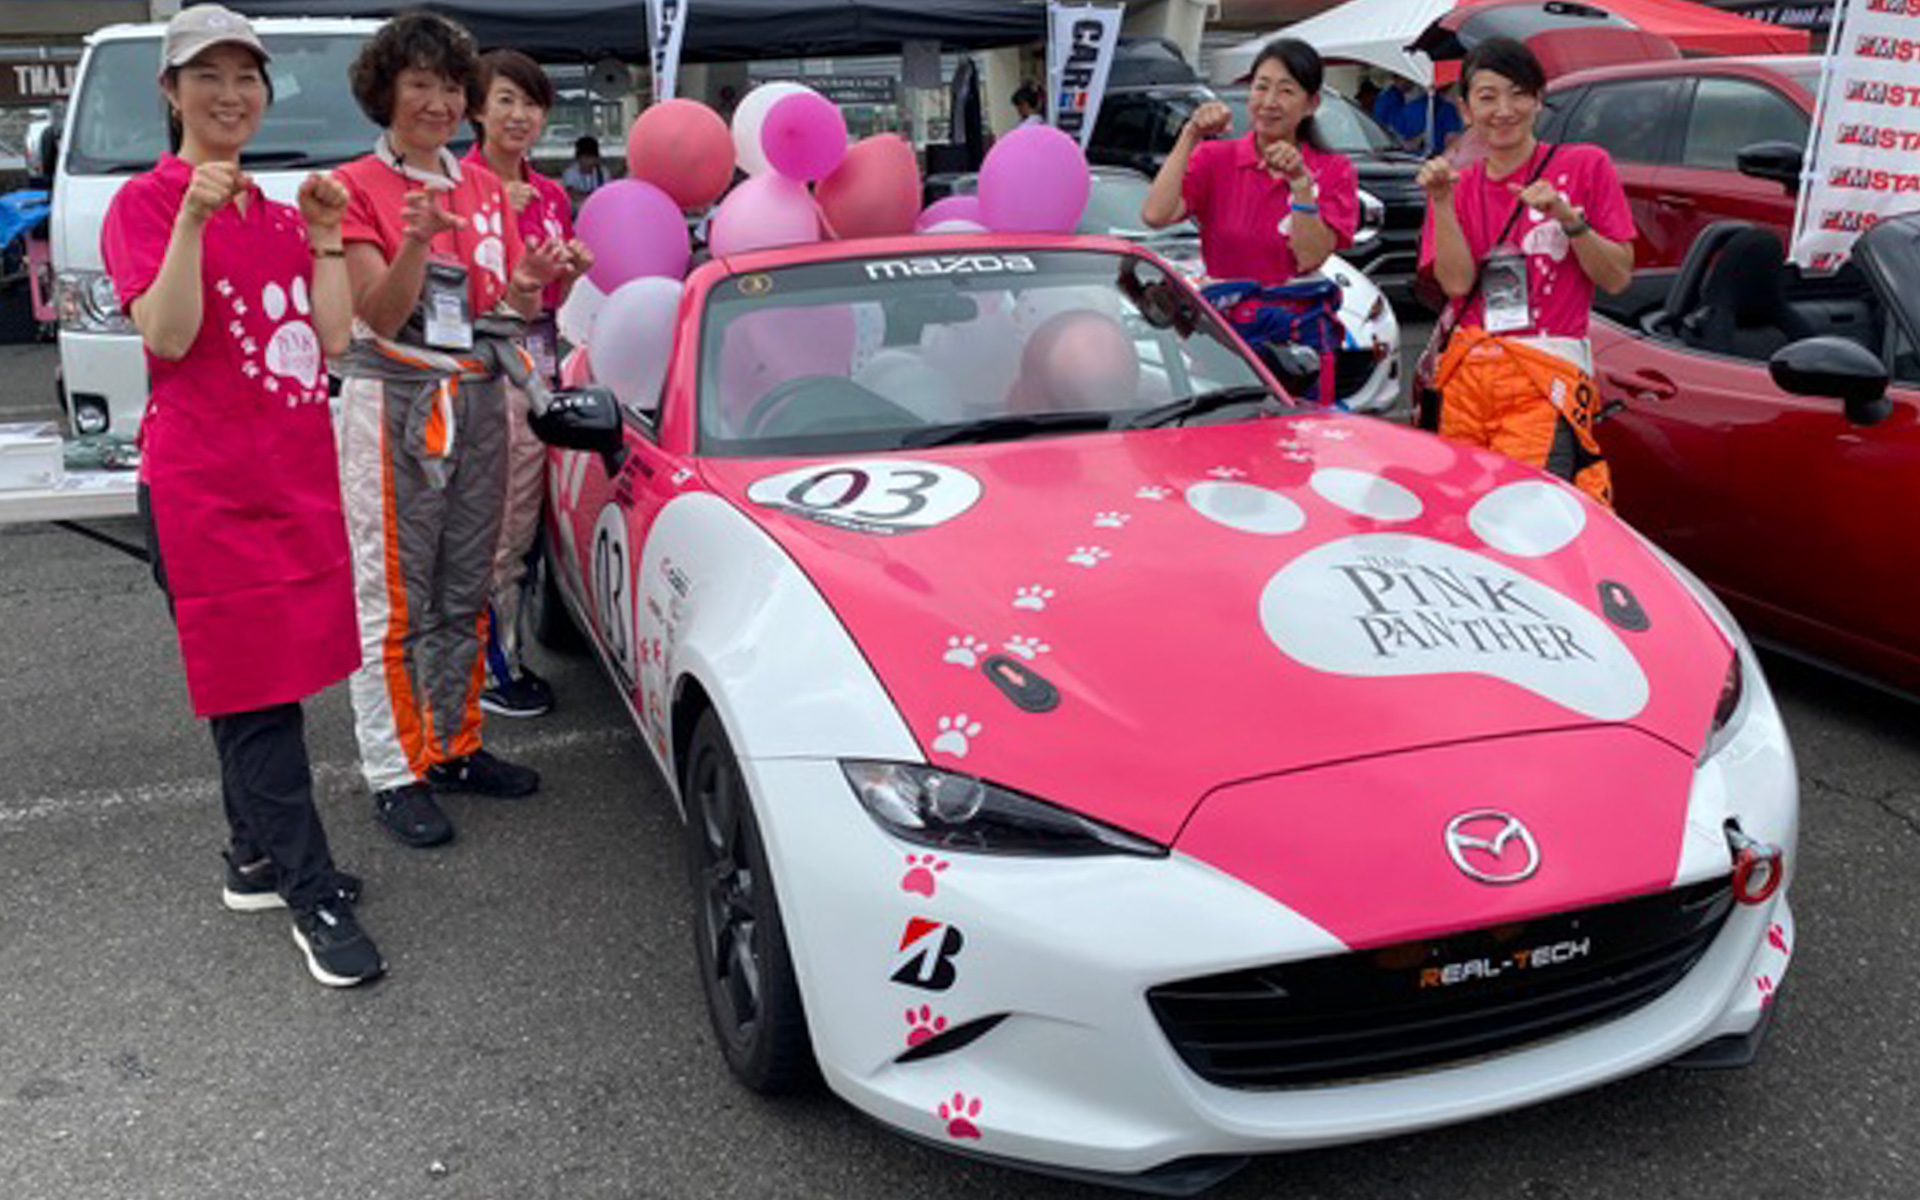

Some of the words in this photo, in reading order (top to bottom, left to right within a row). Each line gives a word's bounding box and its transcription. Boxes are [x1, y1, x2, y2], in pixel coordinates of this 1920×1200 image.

[1061, 20, 1103, 90] CAR
[784, 467, 942, 521] 03
[1329, 563, 1550, 621] PINK
[1352, 609, 1597, 663] PANTHER
[1419, 936, 1591, 988] REAL-TECH
